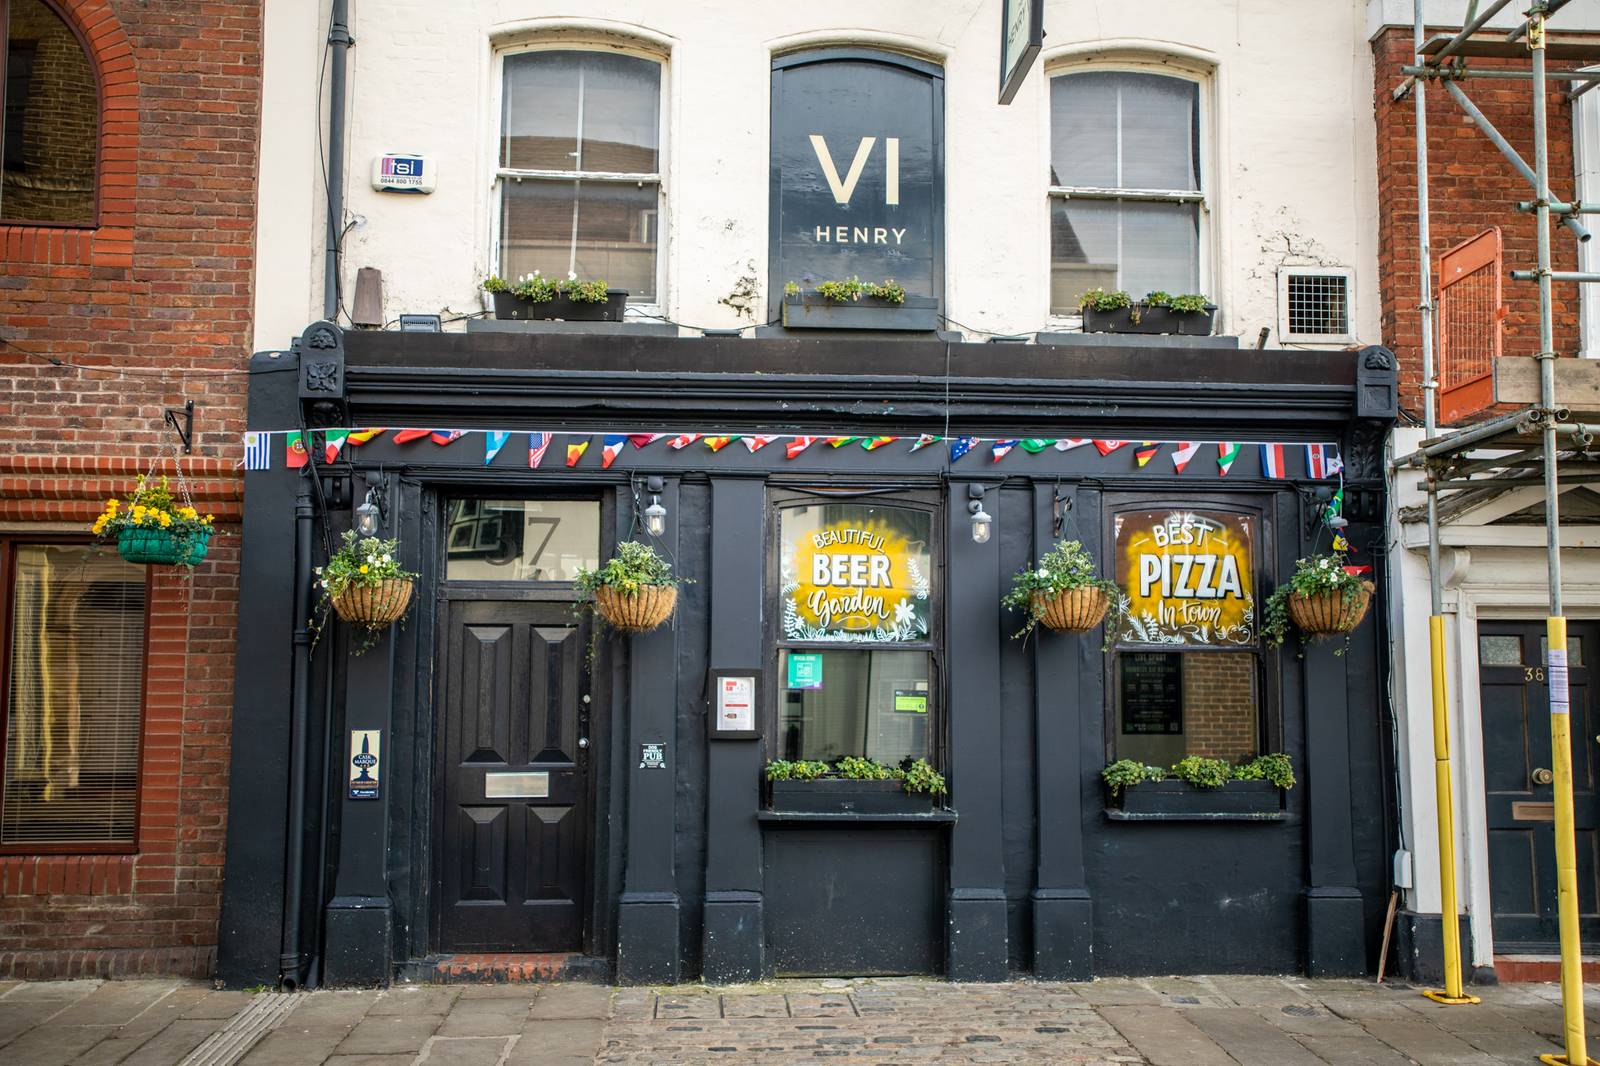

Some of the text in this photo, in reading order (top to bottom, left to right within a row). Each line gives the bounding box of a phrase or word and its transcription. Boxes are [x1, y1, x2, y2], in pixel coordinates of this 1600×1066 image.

[808, 134, 899, 206] VI
[816, 225, 907, 245] HENRY
[812, 529, 886, 554] BEAUTIFUL
[1152, 522, 1215, 548] BEST
[812, 553, 893, 589] BEER
[1140, 553, 1244, 600] PIZZA
[807, 587, 890, 628] Garden
[1158, 600, 1222, 631] In town
[1524, 667, 1544, 682] 38
[643, 752, 663, 760] PUB
